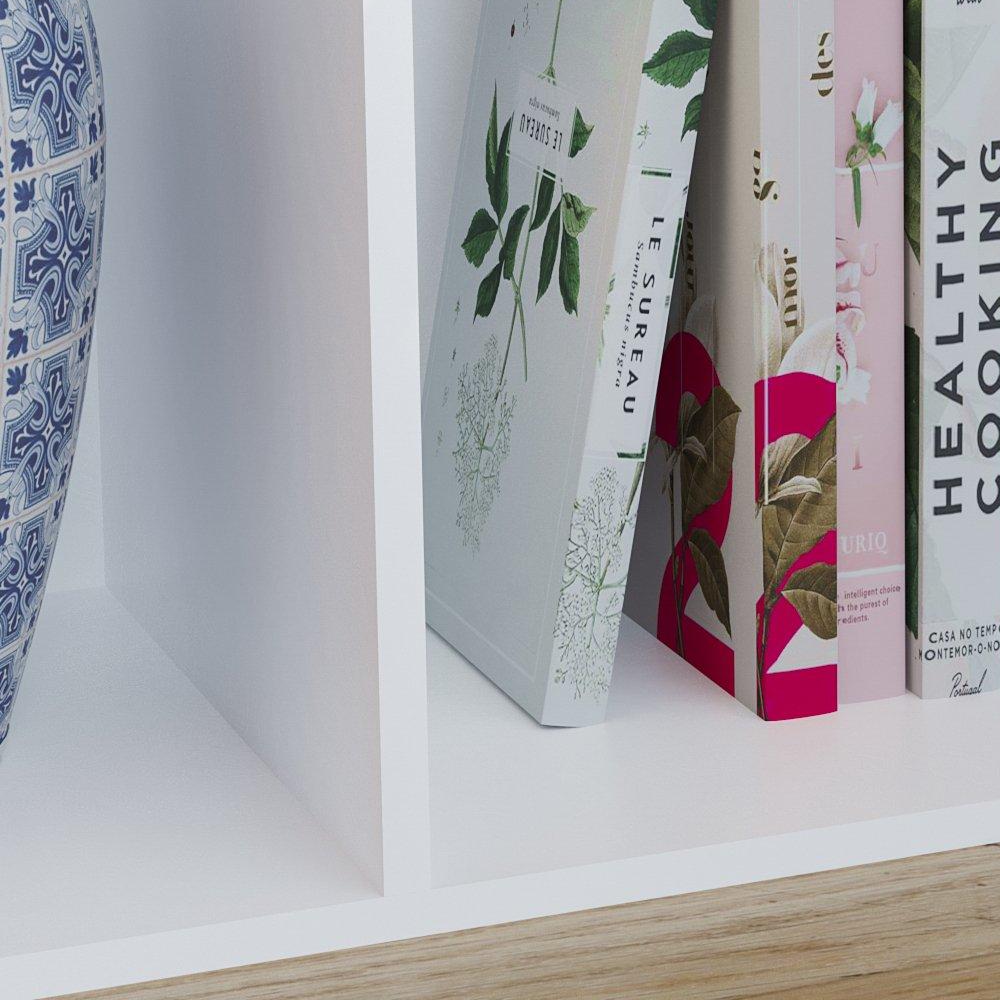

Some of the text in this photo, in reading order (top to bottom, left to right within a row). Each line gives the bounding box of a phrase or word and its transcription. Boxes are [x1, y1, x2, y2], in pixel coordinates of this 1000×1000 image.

[809, 32, 835, 99] des
[520, 113, 563, 152] LE SUREAU
[623, 216, 665, 414] LE SUREAU
[933, 147, 966, 516] HEALTHY
[844, 584, 901, 600] intelligent choice
[847, 601, 859, 612] the
[859, 599, 881, 612] purest
[882, 597, 890, 607] of
[928, 631, 956, 644] CASA
[959, 628, 972, 640] NO
